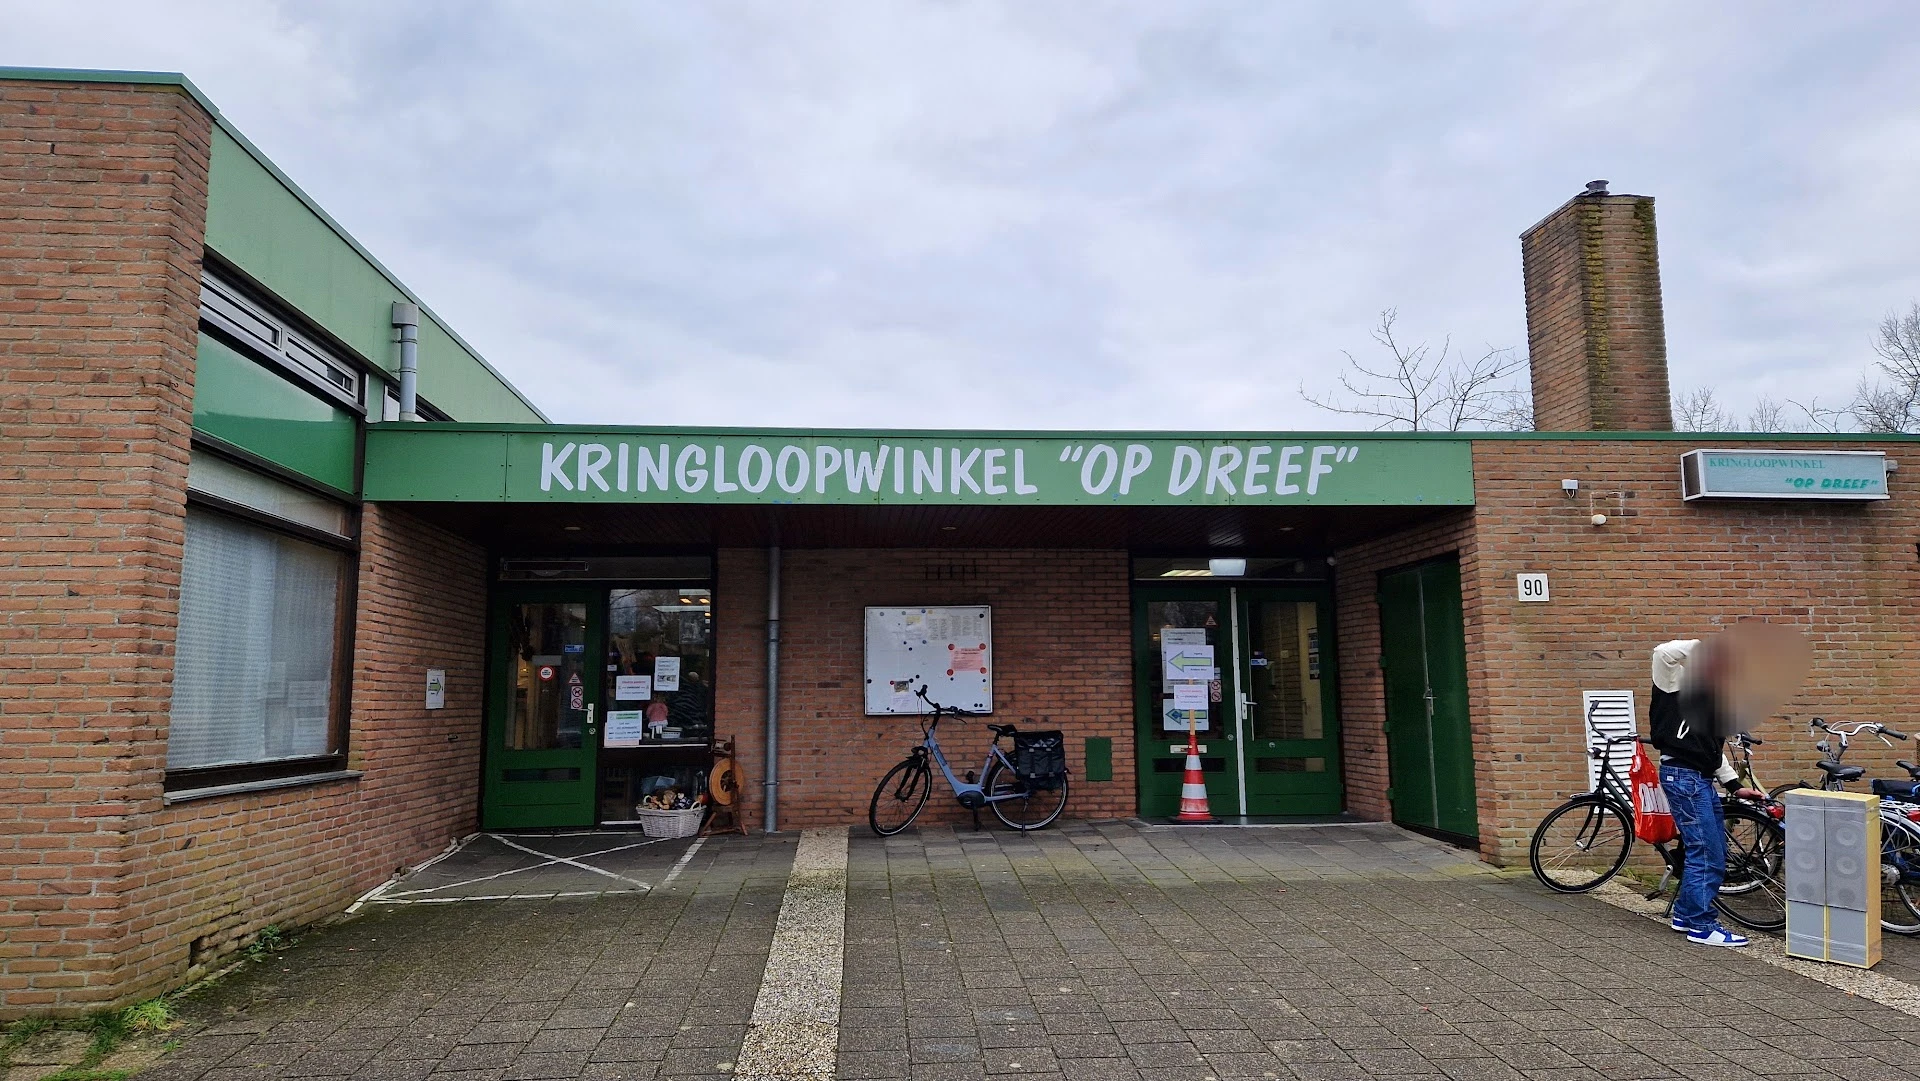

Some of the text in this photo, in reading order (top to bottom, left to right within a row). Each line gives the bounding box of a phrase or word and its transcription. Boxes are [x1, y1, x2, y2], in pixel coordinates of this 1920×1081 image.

[540, 442, 1360, 496] KRINGLOOPWINKEL "OP DREEF"
[1708, 457, 1826, 469] KRINGLOOPWINKEL
[1524, 579, 1543, 596] 90
